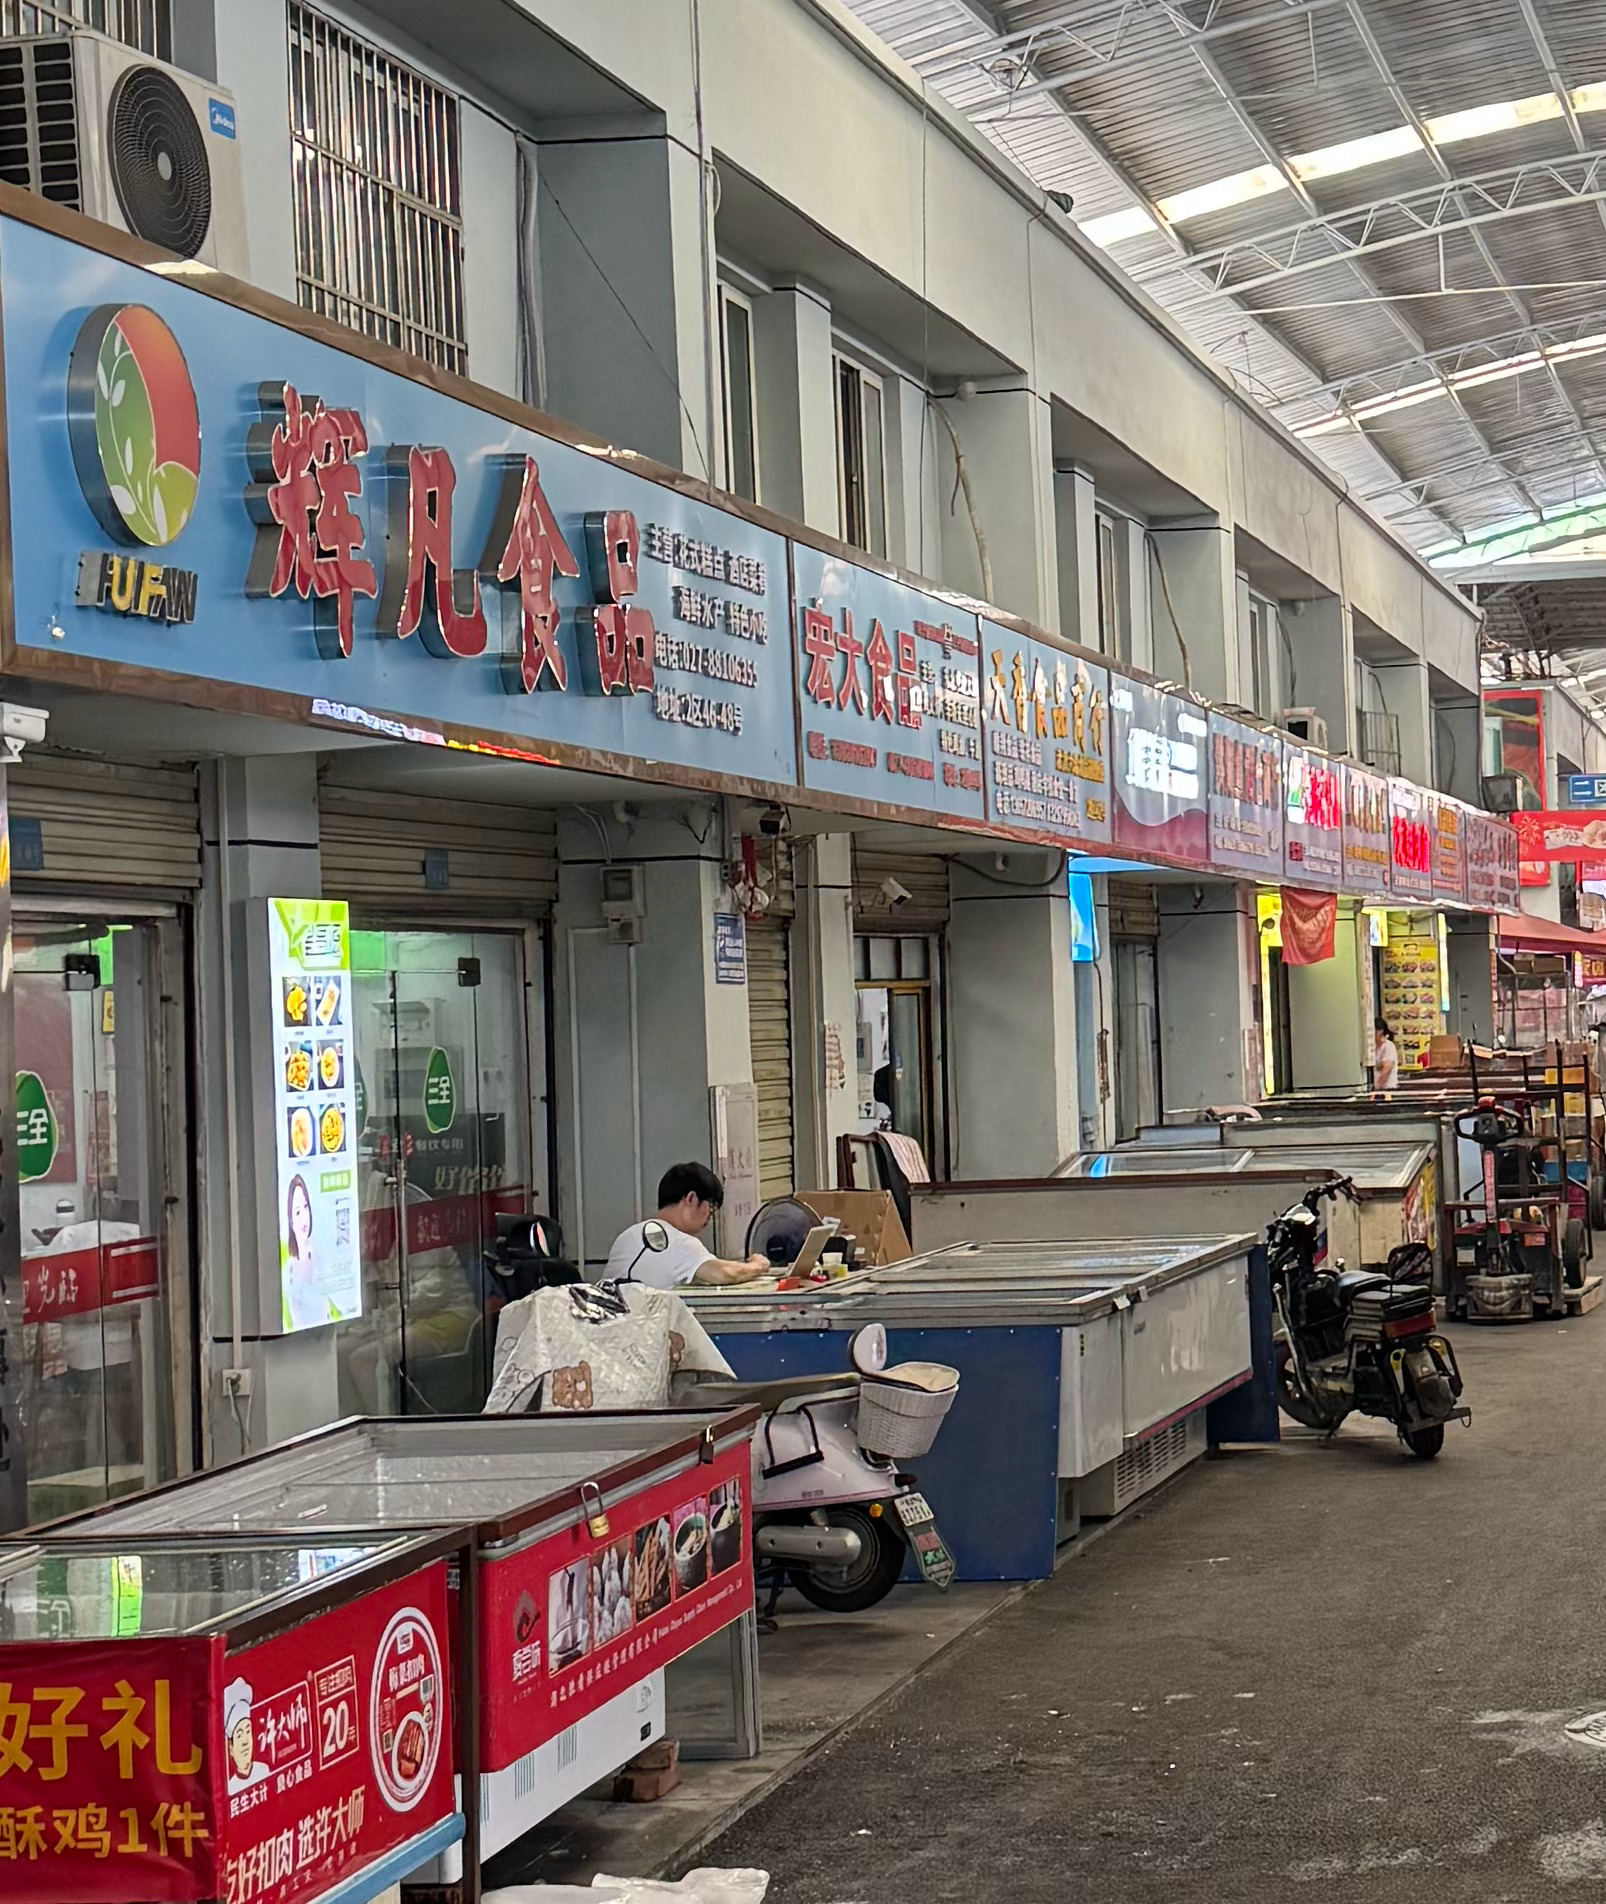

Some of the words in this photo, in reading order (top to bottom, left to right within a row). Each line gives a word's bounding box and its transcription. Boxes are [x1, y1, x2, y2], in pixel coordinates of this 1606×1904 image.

[265, 380, 656, 696] 辉凡食品
[428, 1076, 451, 1105] 三全
[0, 1680, 202, 1781] 好礼
[230, 1785, 268, 1818] 民生大计
[276, 1759, 312, 1794] 良心食品
[0, 1801, 209, 1860] 酥鸡1件
[296, 1785, 365, 1871] 选许大师
